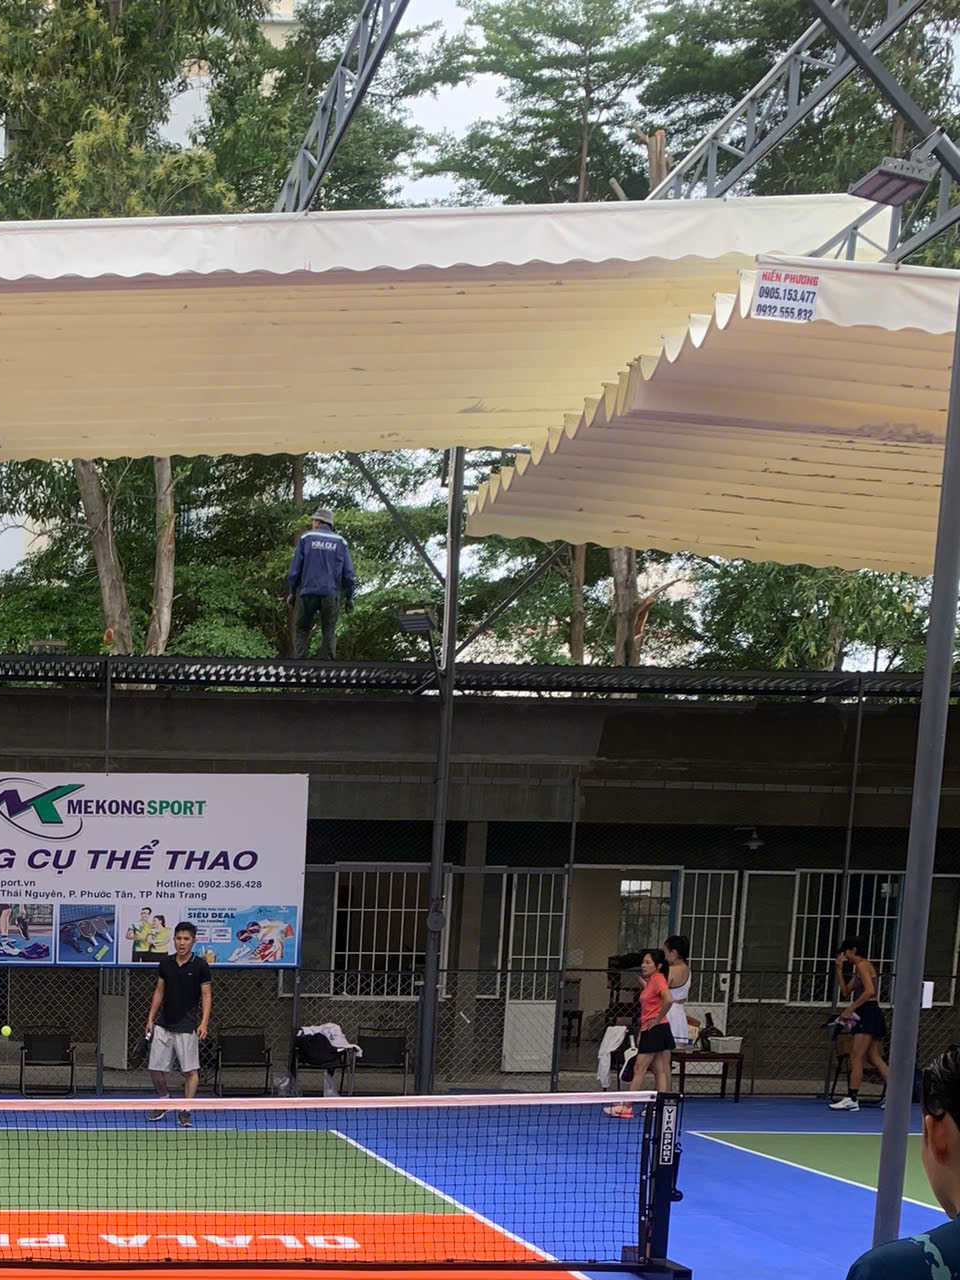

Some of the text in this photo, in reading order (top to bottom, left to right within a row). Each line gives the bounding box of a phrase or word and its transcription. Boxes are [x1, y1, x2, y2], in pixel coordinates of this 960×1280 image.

[759, 286, 816, 303] 0905.153.477
[756, 304, 813, 321] 0932.555.832
[67, 800, 206, 815] MEKONGSPORT
[27, 849, 76, 874] CỤ
[87, 839, 160, 870] THỂ
[166, 850, 258, 871] THAO
[156, 880, 262, 889] Hotline: 0902.356.428
[0, 889, 22, 897] Thái
[24, 890, 66, 899] Nguyên,
[69, 890, 77, 898] P.
[80, 890, 112, 898] Phước
[115, 890, 136, 900] Tân,
[140, 891, 152, 899] TP
[155, 891, 176, 899] Nha
[178, 891, 207, 900] Trang
